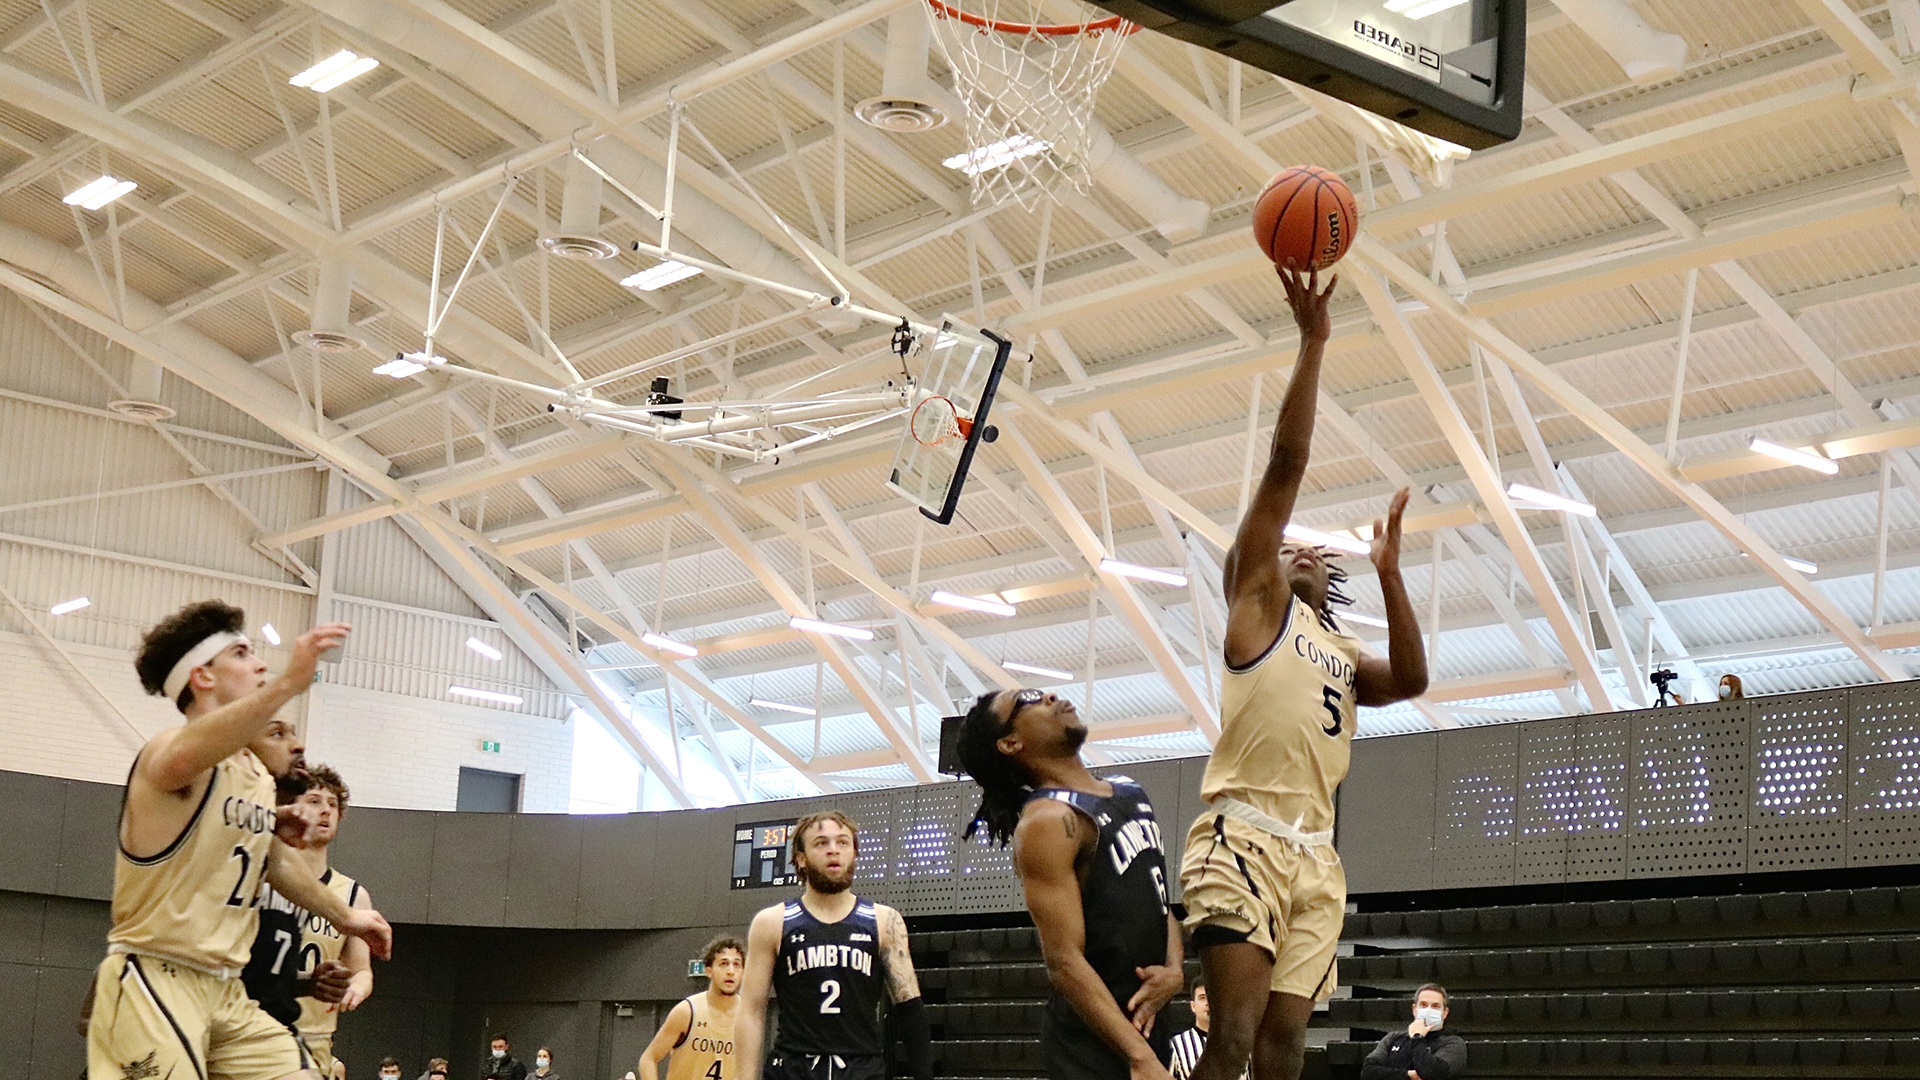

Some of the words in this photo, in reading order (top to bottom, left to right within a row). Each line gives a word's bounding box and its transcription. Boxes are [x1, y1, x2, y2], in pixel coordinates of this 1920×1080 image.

[1321, 684, 1343, 737] 5
[735, 829, 754, 841] HOME
[762, 827, 786, 846] 3:57
[270, 929, 292, 975] 7
[786, 944, 872, 977] LAMBTON
[820, 979, 841, 1014] 2
[705, 1060, 723, 1080] 4
